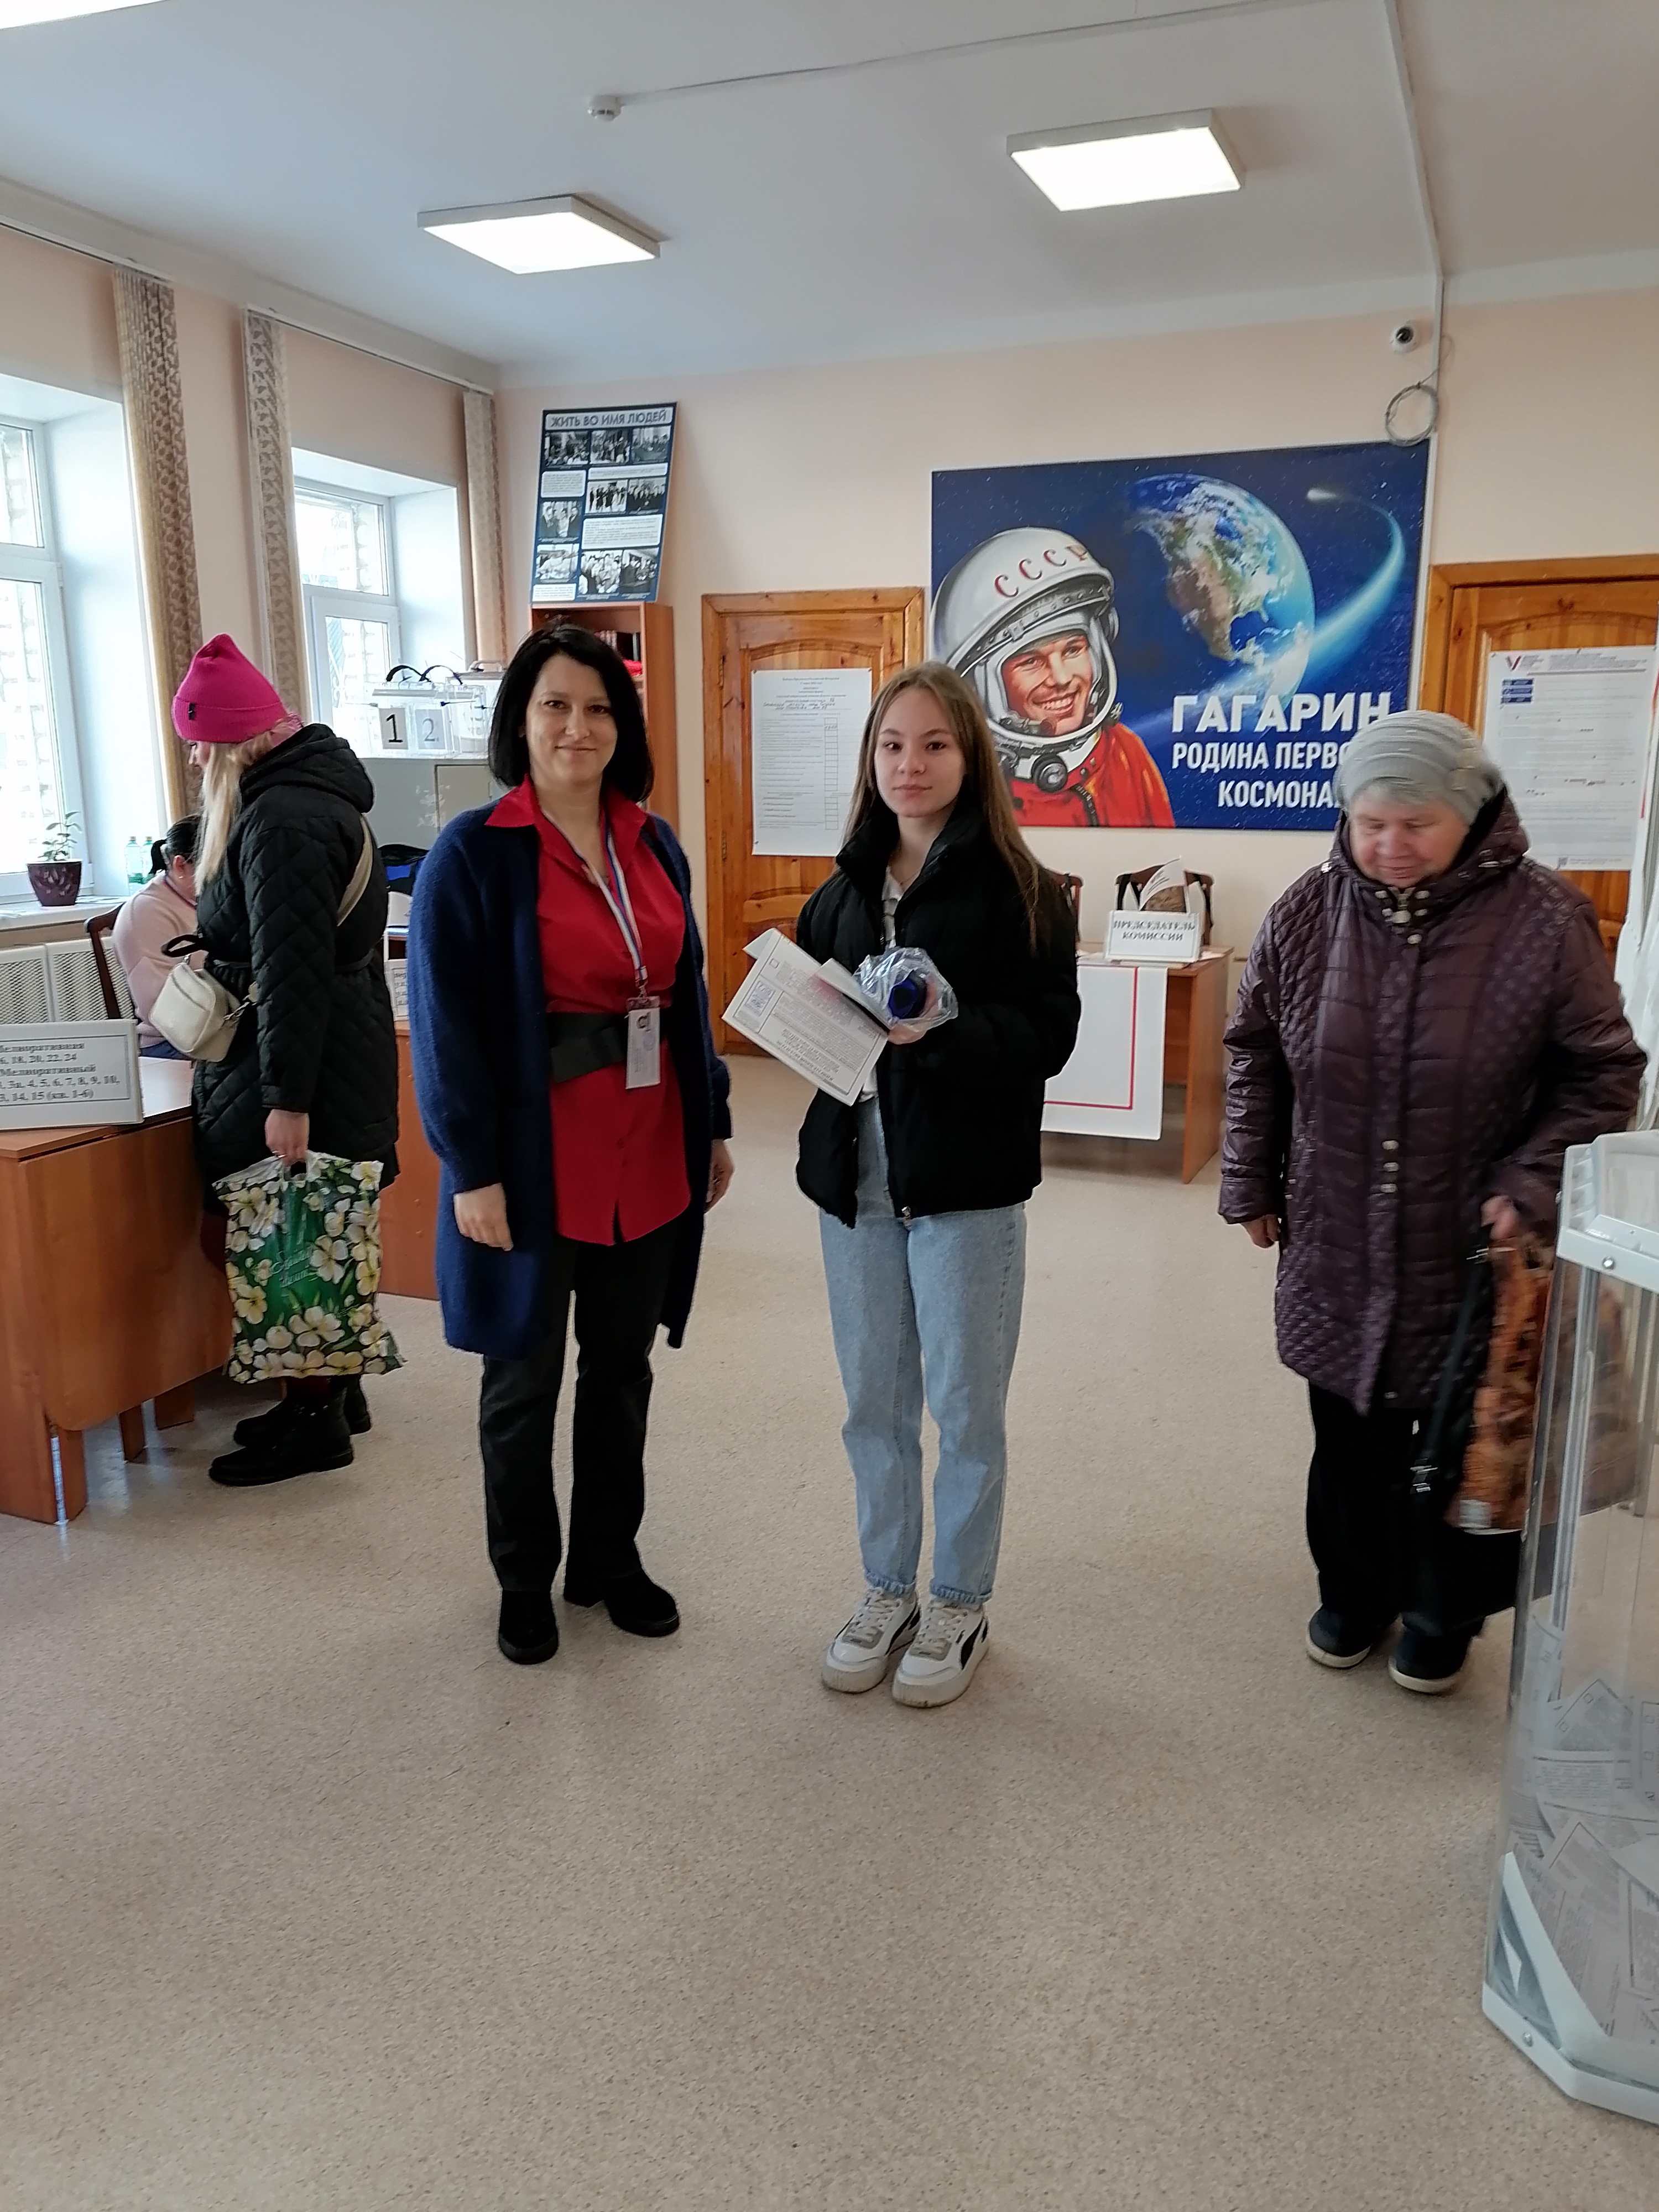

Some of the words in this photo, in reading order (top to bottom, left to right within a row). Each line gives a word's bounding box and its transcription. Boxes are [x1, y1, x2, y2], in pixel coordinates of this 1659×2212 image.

[550, 416, 580, 427] ЖИТЬ
[583, 415, 599, 426] ВО
[602, 414, 625, 425] ИМЯ
[628, 409, 667, 424] ЛЮДЕЙ
[994, 542, 1089, 598] СССР
[1171, 691, 1391, 733] ГАГАРИН
[387, 713, 404, 743] 1
[422, 718, 439, 742] 2
[1171, 742, 1270, 774] РОДИНА
[1274, 741, 1350, 770] ПЕРВ
[1218, 780, 1338, 808] КОСМОНА
[1113, 921, 1196, 930] ПРЕДСЕДАТЕЛЬ
[1122, 932, 1183, 941] КОМИССИИ
